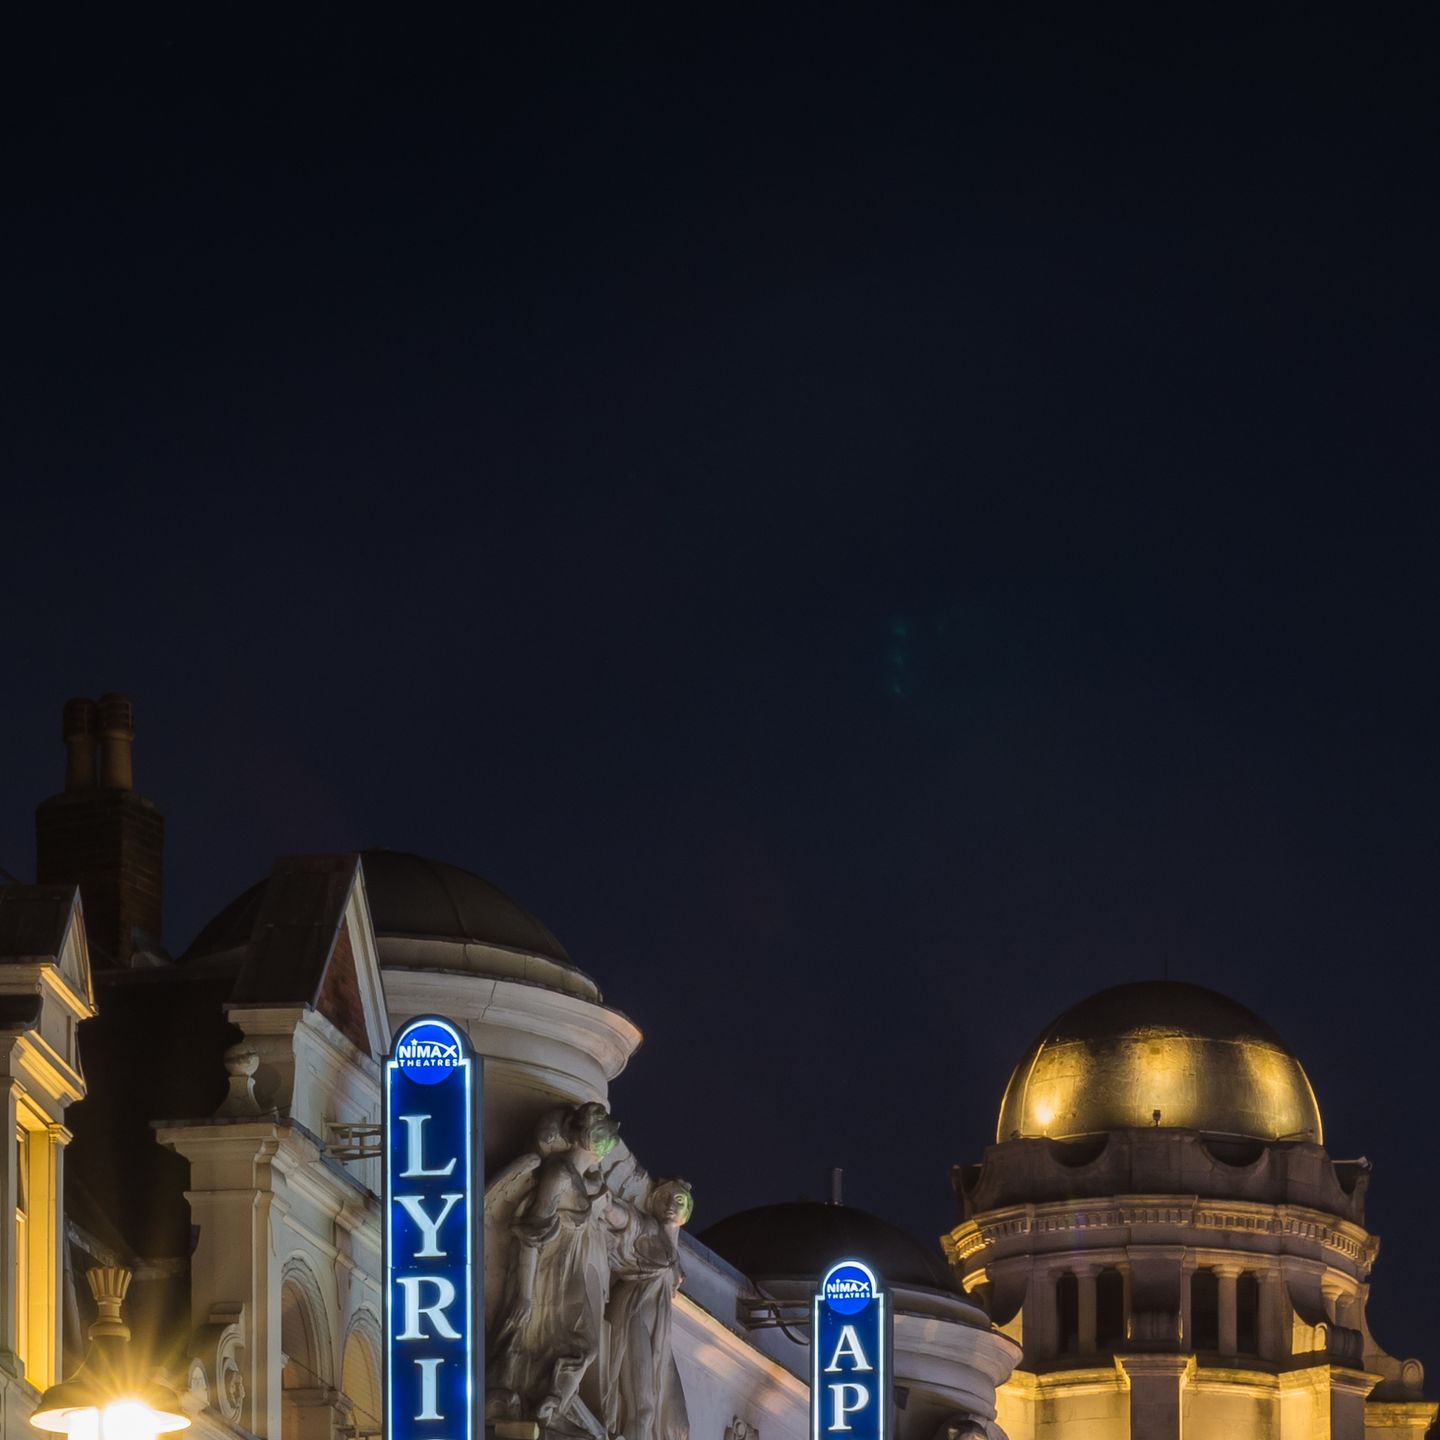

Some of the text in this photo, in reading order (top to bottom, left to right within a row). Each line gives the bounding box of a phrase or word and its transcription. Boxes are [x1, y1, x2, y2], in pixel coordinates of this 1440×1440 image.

[399, 1039, 458, 1058] NIMAX
[399, 1059, 458, 1067] THEATRES
[827, 1279, 870, 1293] NIMAX
